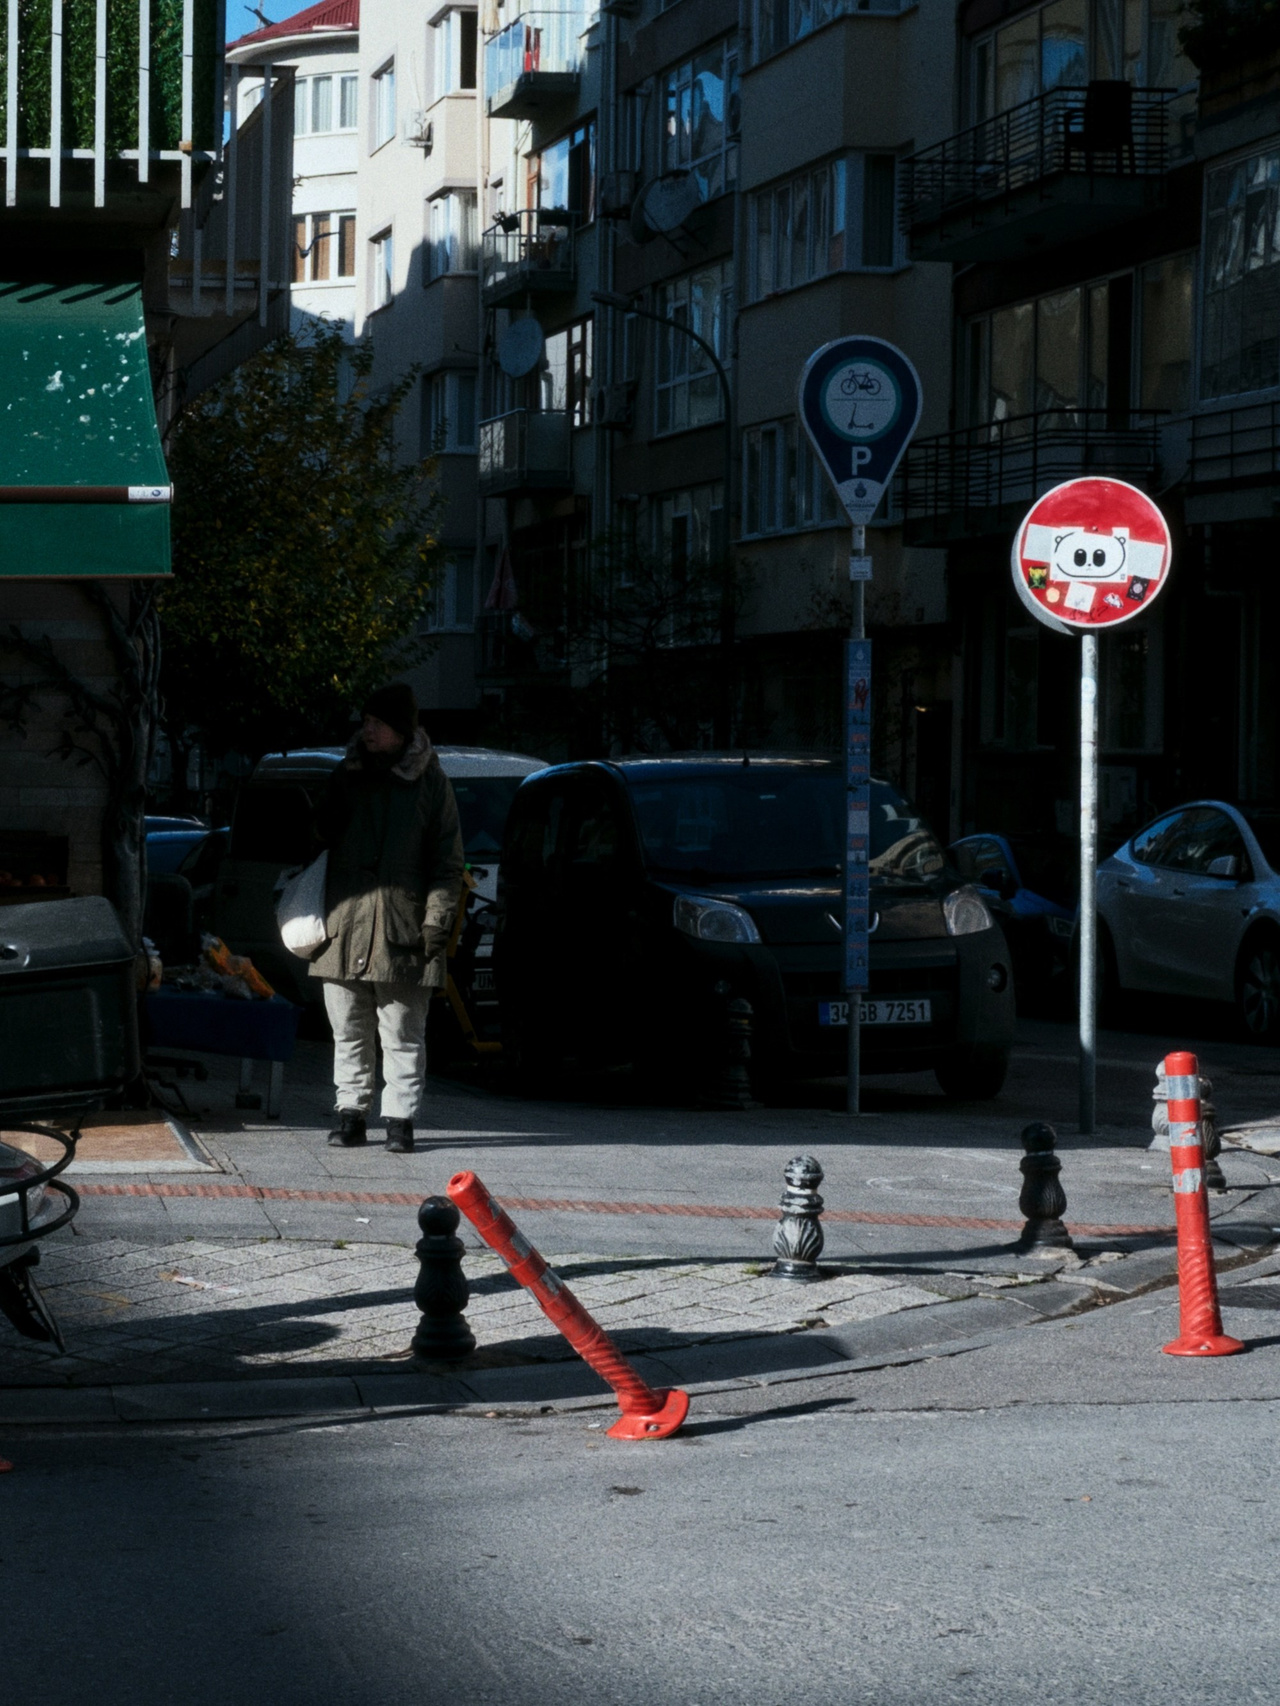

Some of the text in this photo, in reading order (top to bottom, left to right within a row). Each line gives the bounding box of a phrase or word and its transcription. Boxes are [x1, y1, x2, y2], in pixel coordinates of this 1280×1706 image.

[851, 446, 872, 476] P
[831, 1004, 849, 1024] 34
[886, 1002, 926, 1022] 7251
